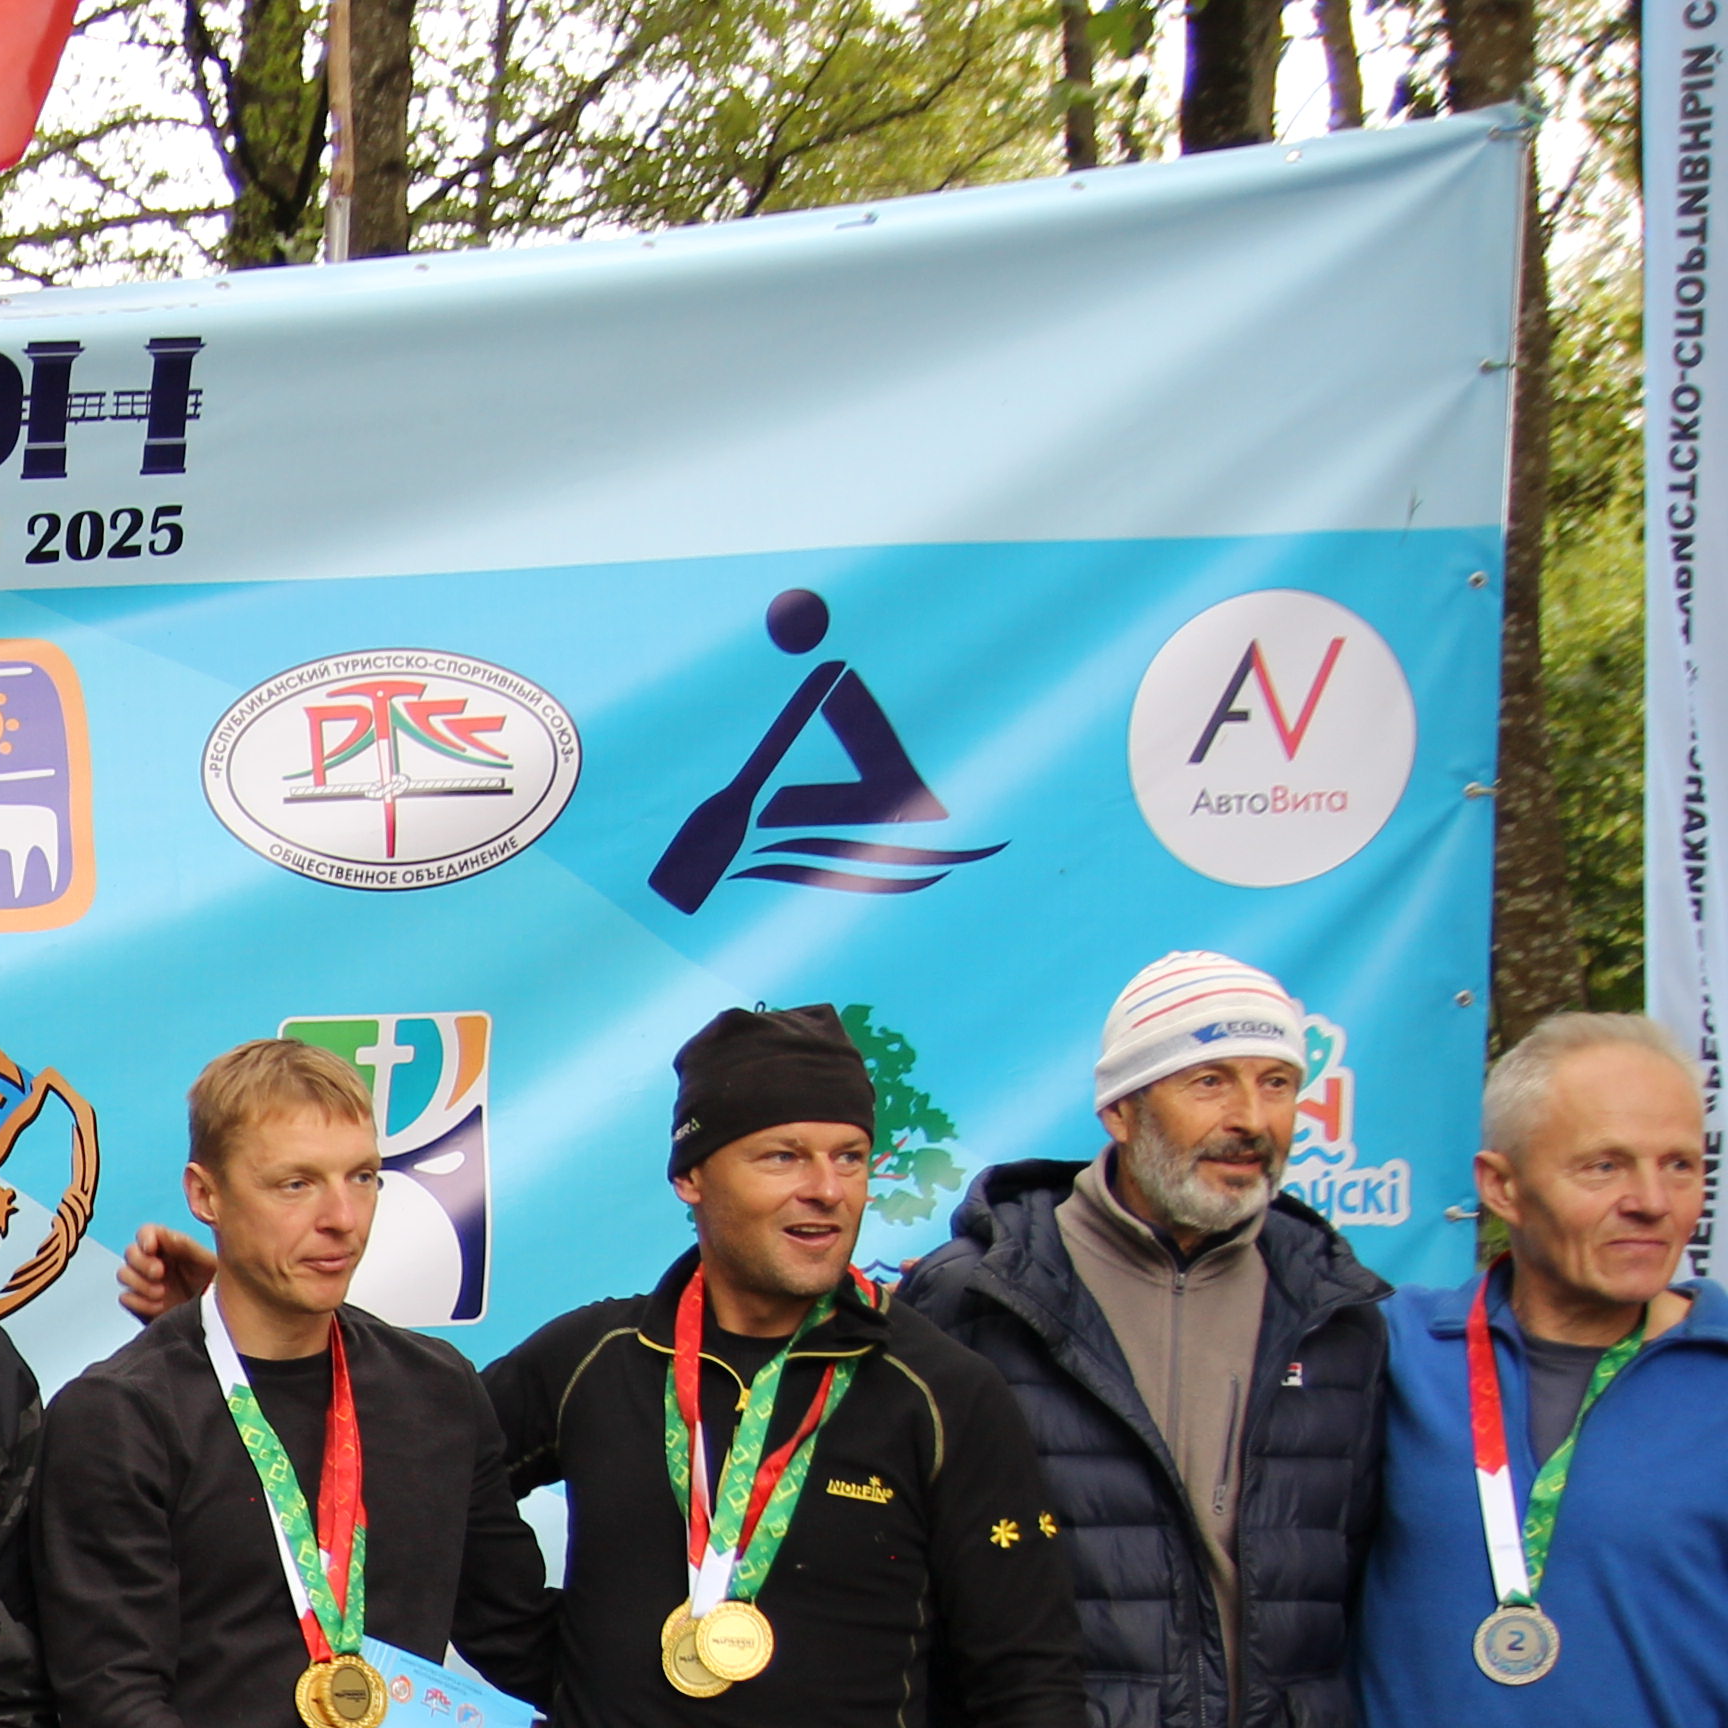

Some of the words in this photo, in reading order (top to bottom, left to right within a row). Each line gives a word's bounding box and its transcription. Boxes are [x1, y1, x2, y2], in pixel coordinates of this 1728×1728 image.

[25, 505, 185, 565] 2025
[333, 655, 544, 706] ТУРИСТСКО-СПОРТИВНЫЙ
[1189, 784, 1349, 816] АвтоВита
[268, 842, 398, 886] ОБЩЕСТВЕННОЕ
[401, 834, 519, 884] ОБЪЕДИНЕНИЕ
[1507, 1629, 1527, 1652] 2
